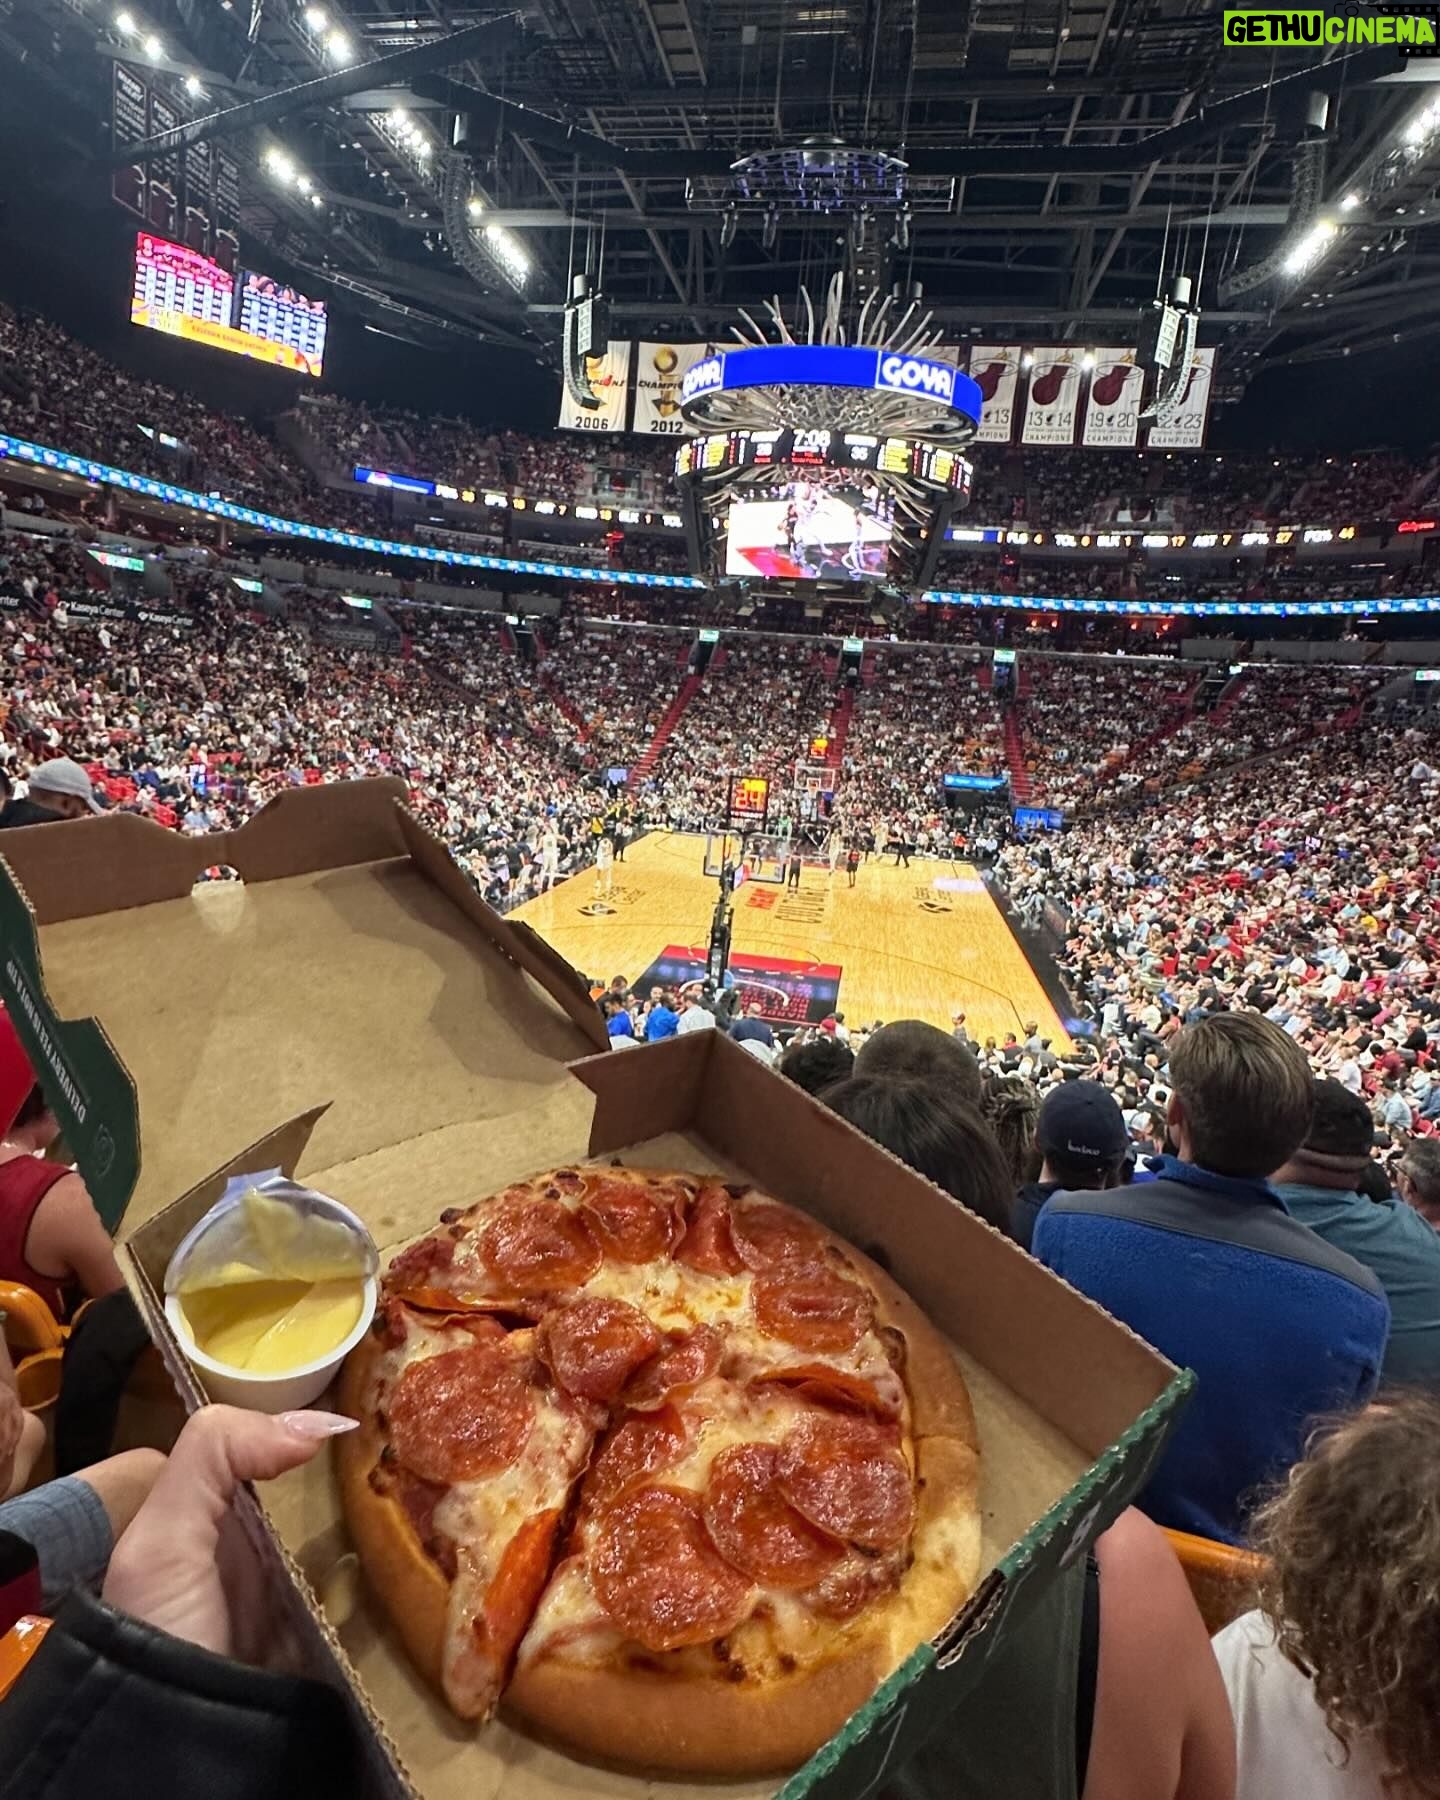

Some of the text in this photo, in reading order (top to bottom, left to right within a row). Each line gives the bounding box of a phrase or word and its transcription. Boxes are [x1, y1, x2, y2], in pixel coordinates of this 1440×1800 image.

[882, 357, 951, 395] GOYA
[575, 417, 608, 430] 2006
[994, 409, 1009, 424] 13
[1029, 411, 1072, 427] 13 14
[1090, 412, 1135, 428] 19 20
[1184, 414, 1202, 429] 23
[651, 421, 683, 433] 2012
[793, 429, 831, 447] 7:08
[50, 1051, 87, 1124] DELIVERY
